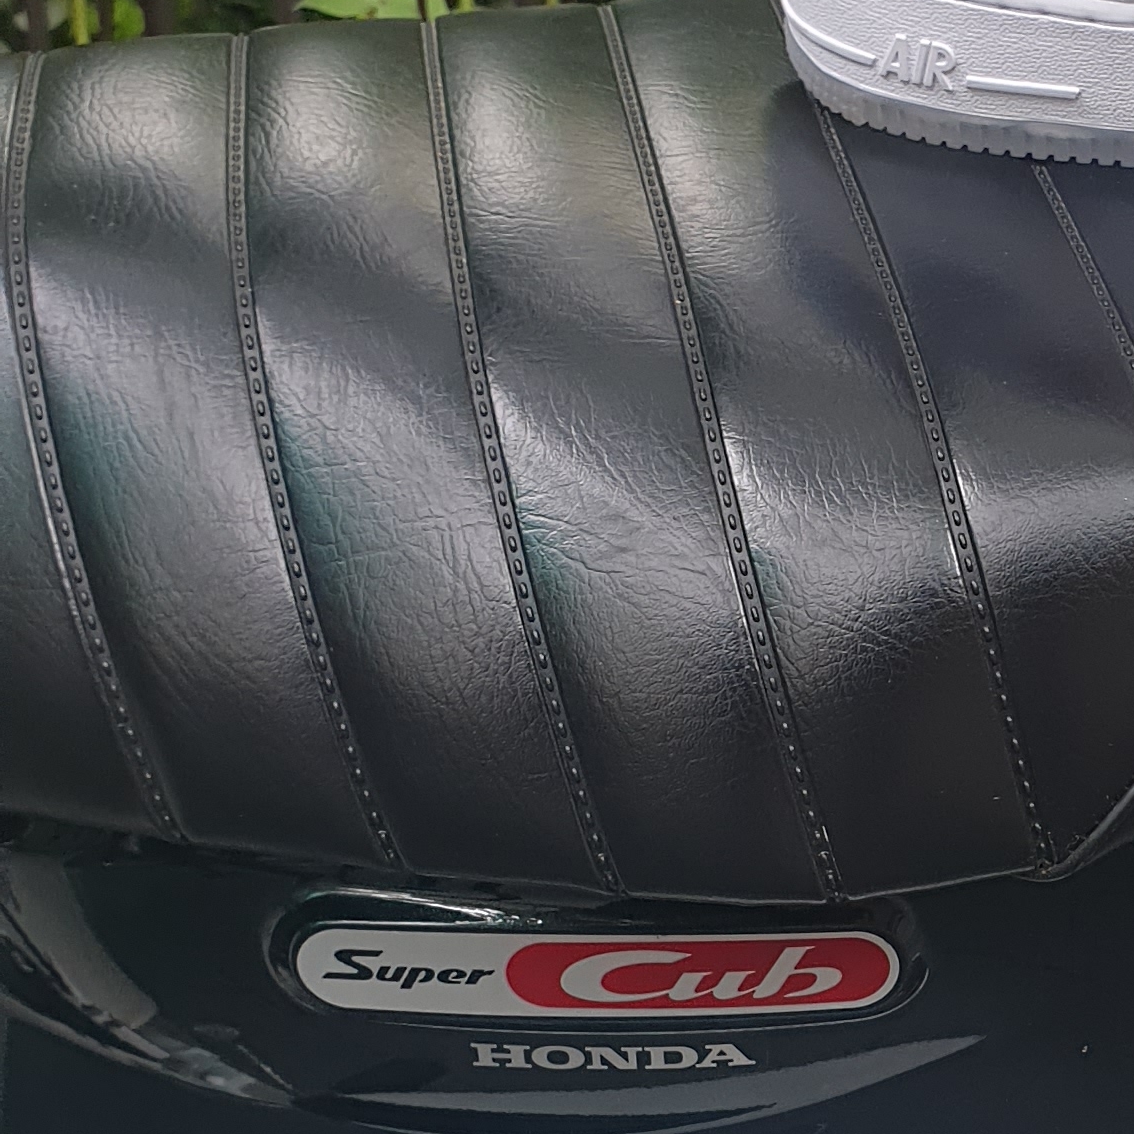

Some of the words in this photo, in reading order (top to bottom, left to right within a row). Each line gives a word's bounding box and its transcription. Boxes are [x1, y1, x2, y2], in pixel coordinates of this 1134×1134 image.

[879, 33, 957, 91] AIR
[323, 949, 495, 989] Super
[560, 946, 843, 1003] Cub
[471, 1042, 757, 1070] HONDA
